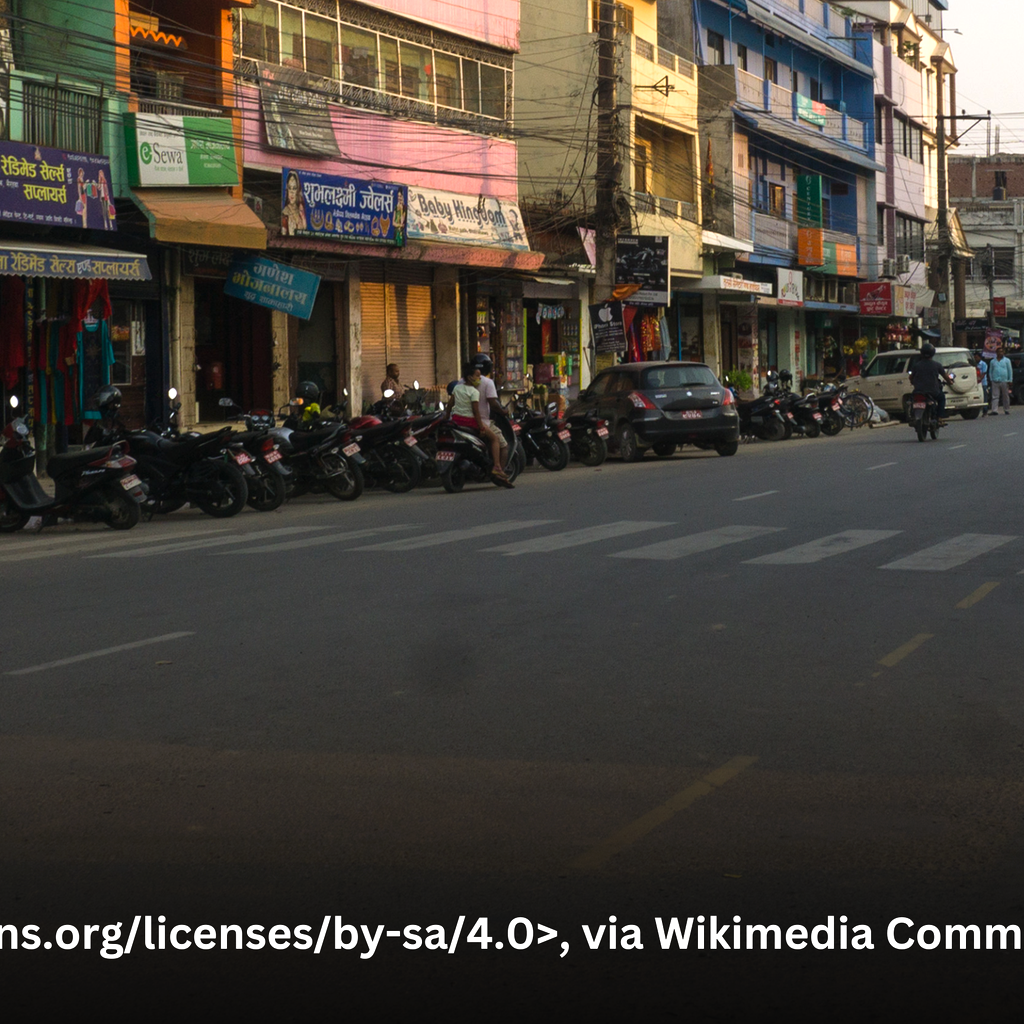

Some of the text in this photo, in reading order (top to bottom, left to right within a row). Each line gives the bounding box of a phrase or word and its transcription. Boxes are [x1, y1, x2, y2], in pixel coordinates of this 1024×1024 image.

[0, 155, 37, 177] रेडिमेड
[23, 183, 67, 204] सप्लायर्स
[359, 185, 394, 213] ज्वेलर्स
[417, 193, 454, 225] Baby
[253, 262, 294, 285] गणेश
[232, 271, 308, 305] भोजनालय
